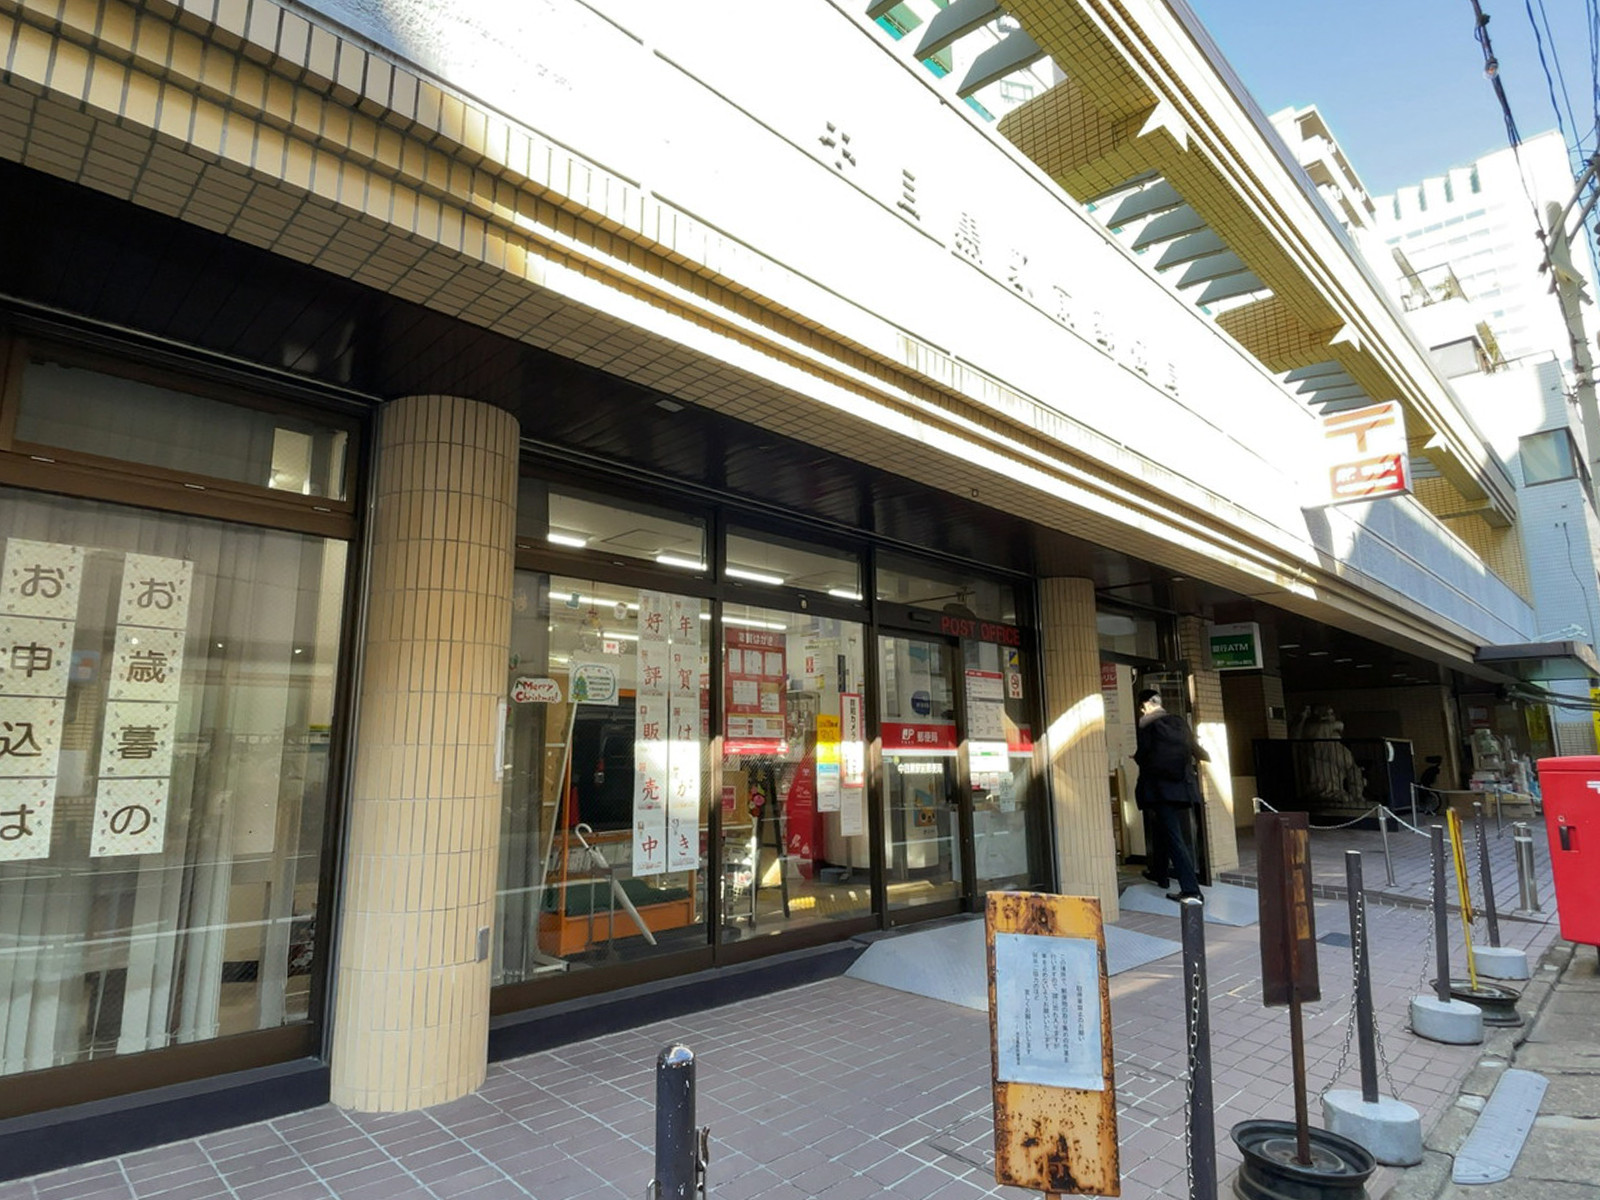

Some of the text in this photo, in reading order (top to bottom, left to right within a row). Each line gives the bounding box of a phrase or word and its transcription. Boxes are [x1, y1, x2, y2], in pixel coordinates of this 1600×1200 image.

[109, 577, 175, 836] お歳暮の
[642, 612, 664, 860] 好評販売中
[941, 616, 1020, 647] POST OFFICE
